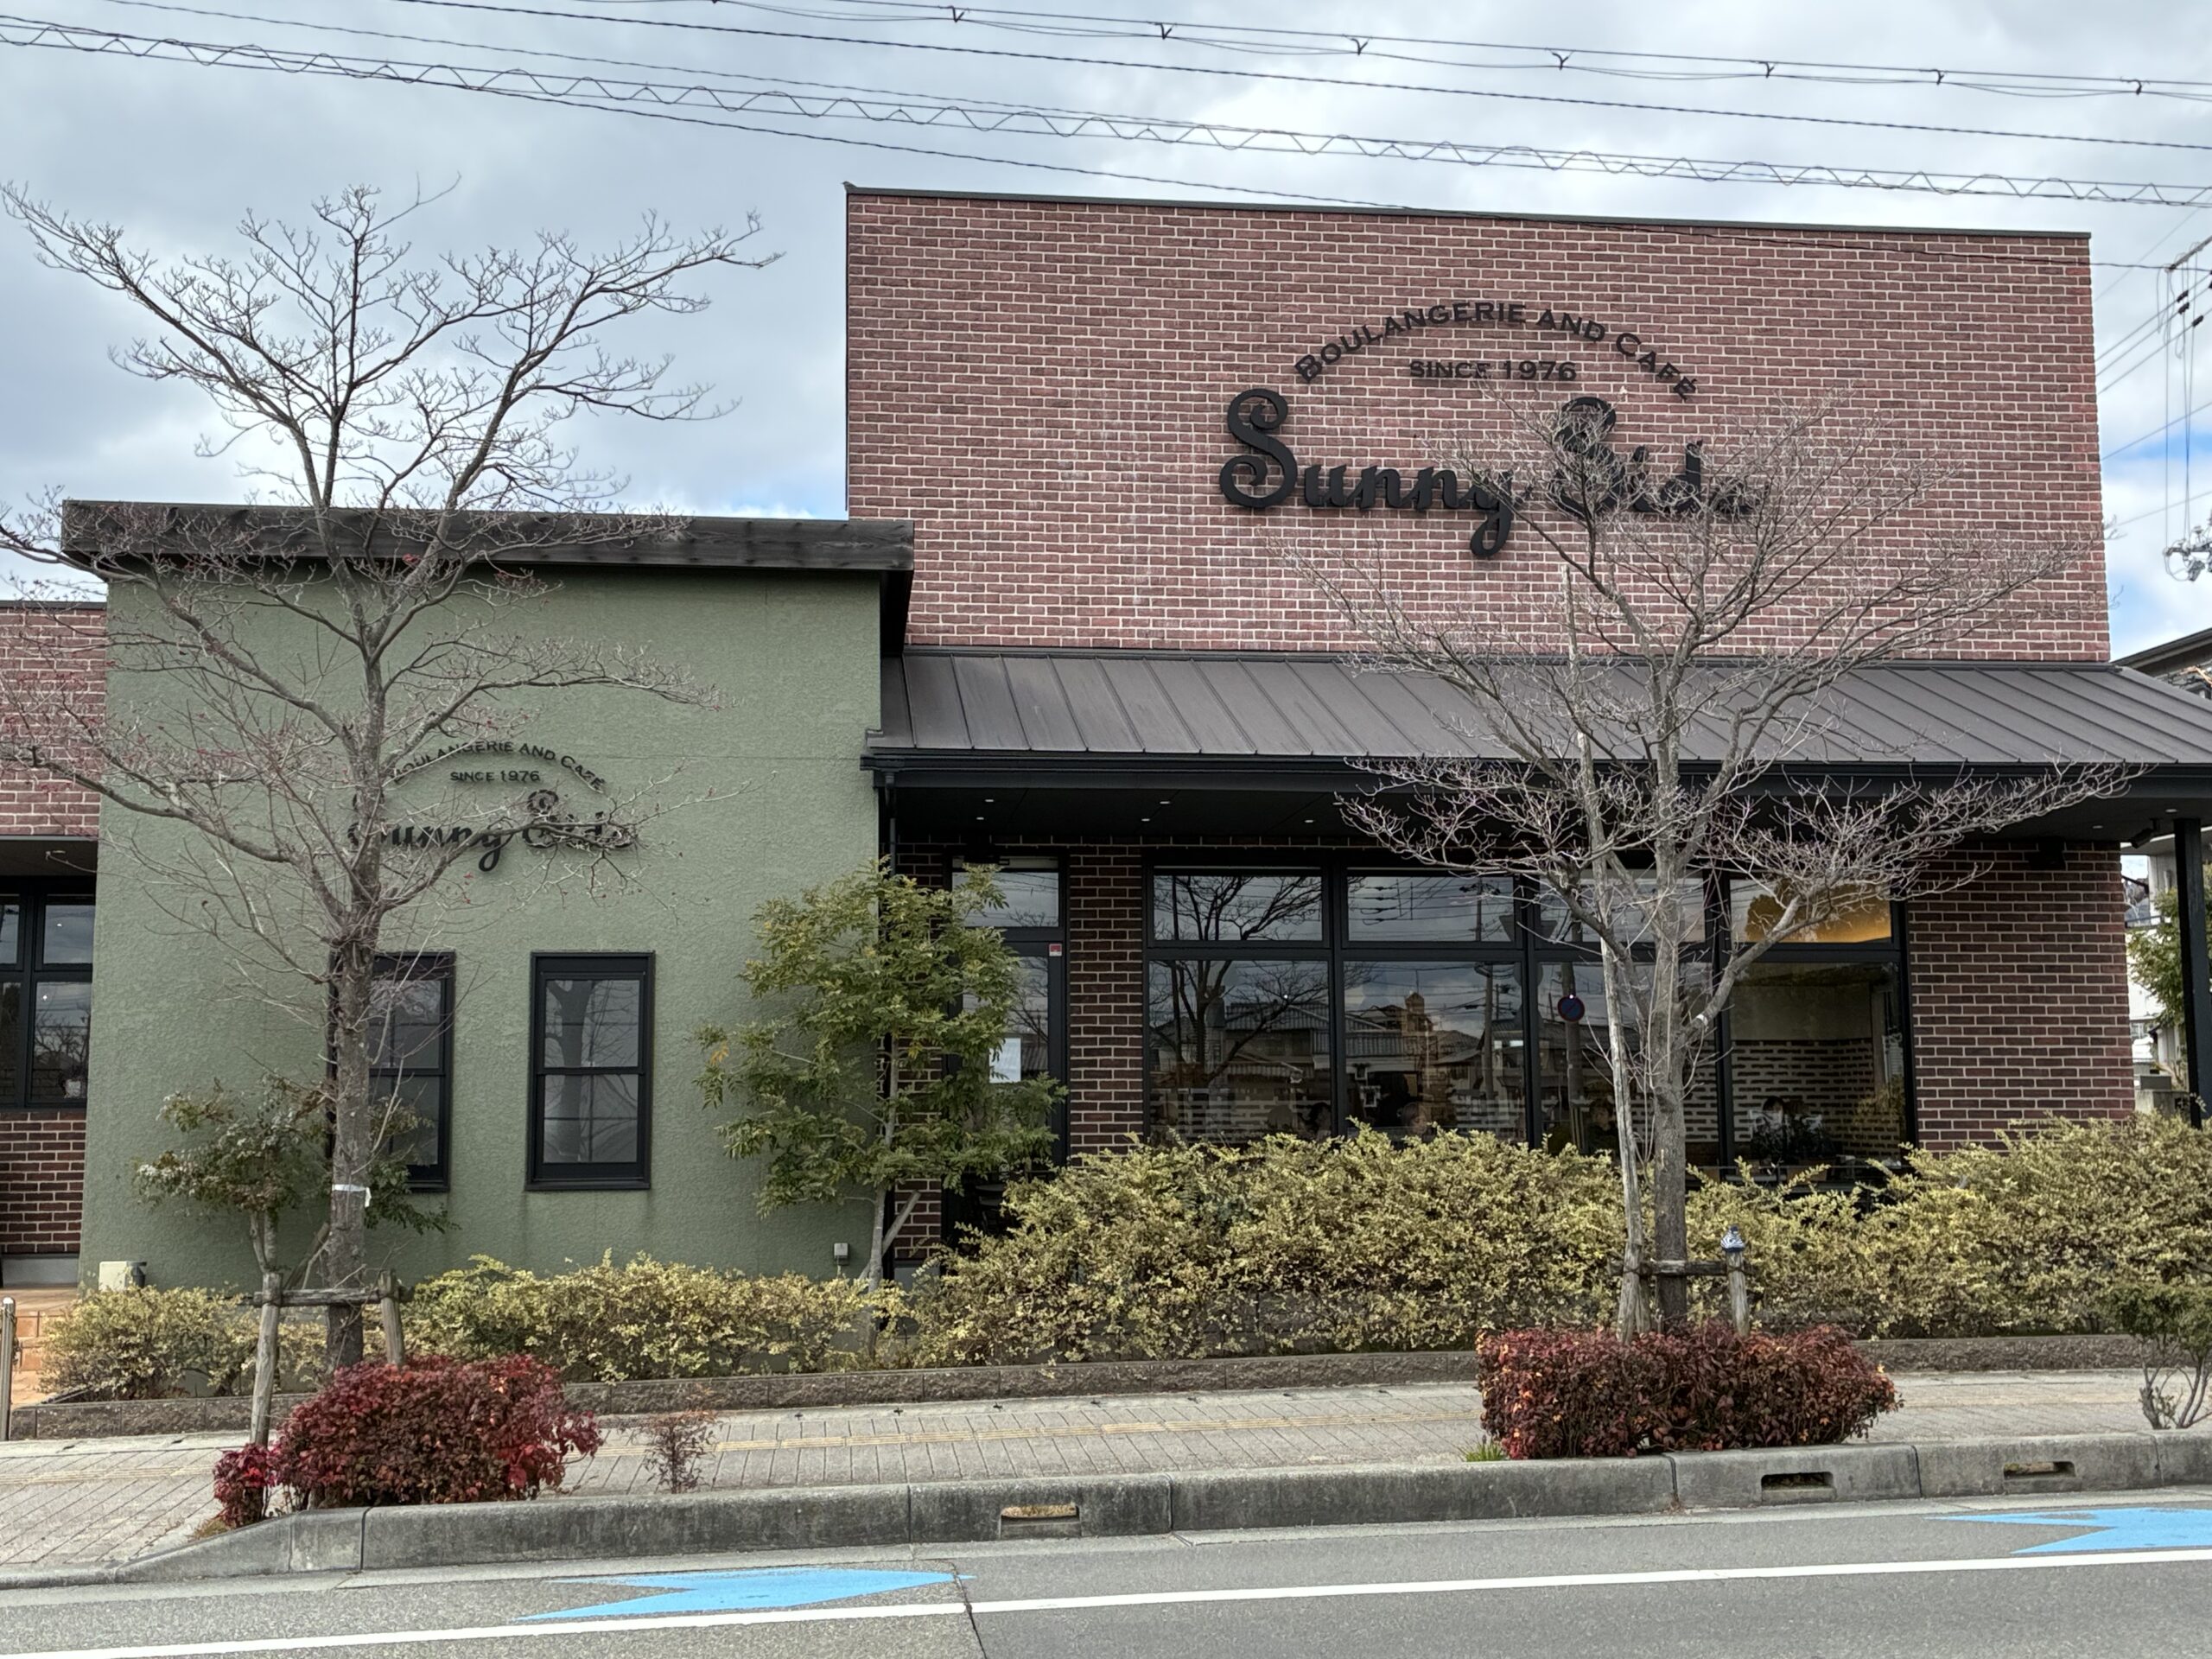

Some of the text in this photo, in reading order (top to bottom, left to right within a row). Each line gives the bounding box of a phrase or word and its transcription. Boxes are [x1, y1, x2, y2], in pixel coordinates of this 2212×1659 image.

[1295, 302, 1527, 384] BOULANGERIE
[1535, 308, 1605, 343] AND
[1408, 359, 1577, 382] SINCE 1976
[1219, 388, 1532, 557] Sunny
[450, 770, 541, 782] SINCE 1976
[518, 743, 556, 760] AND
[347, 790, 512, 872] unny
